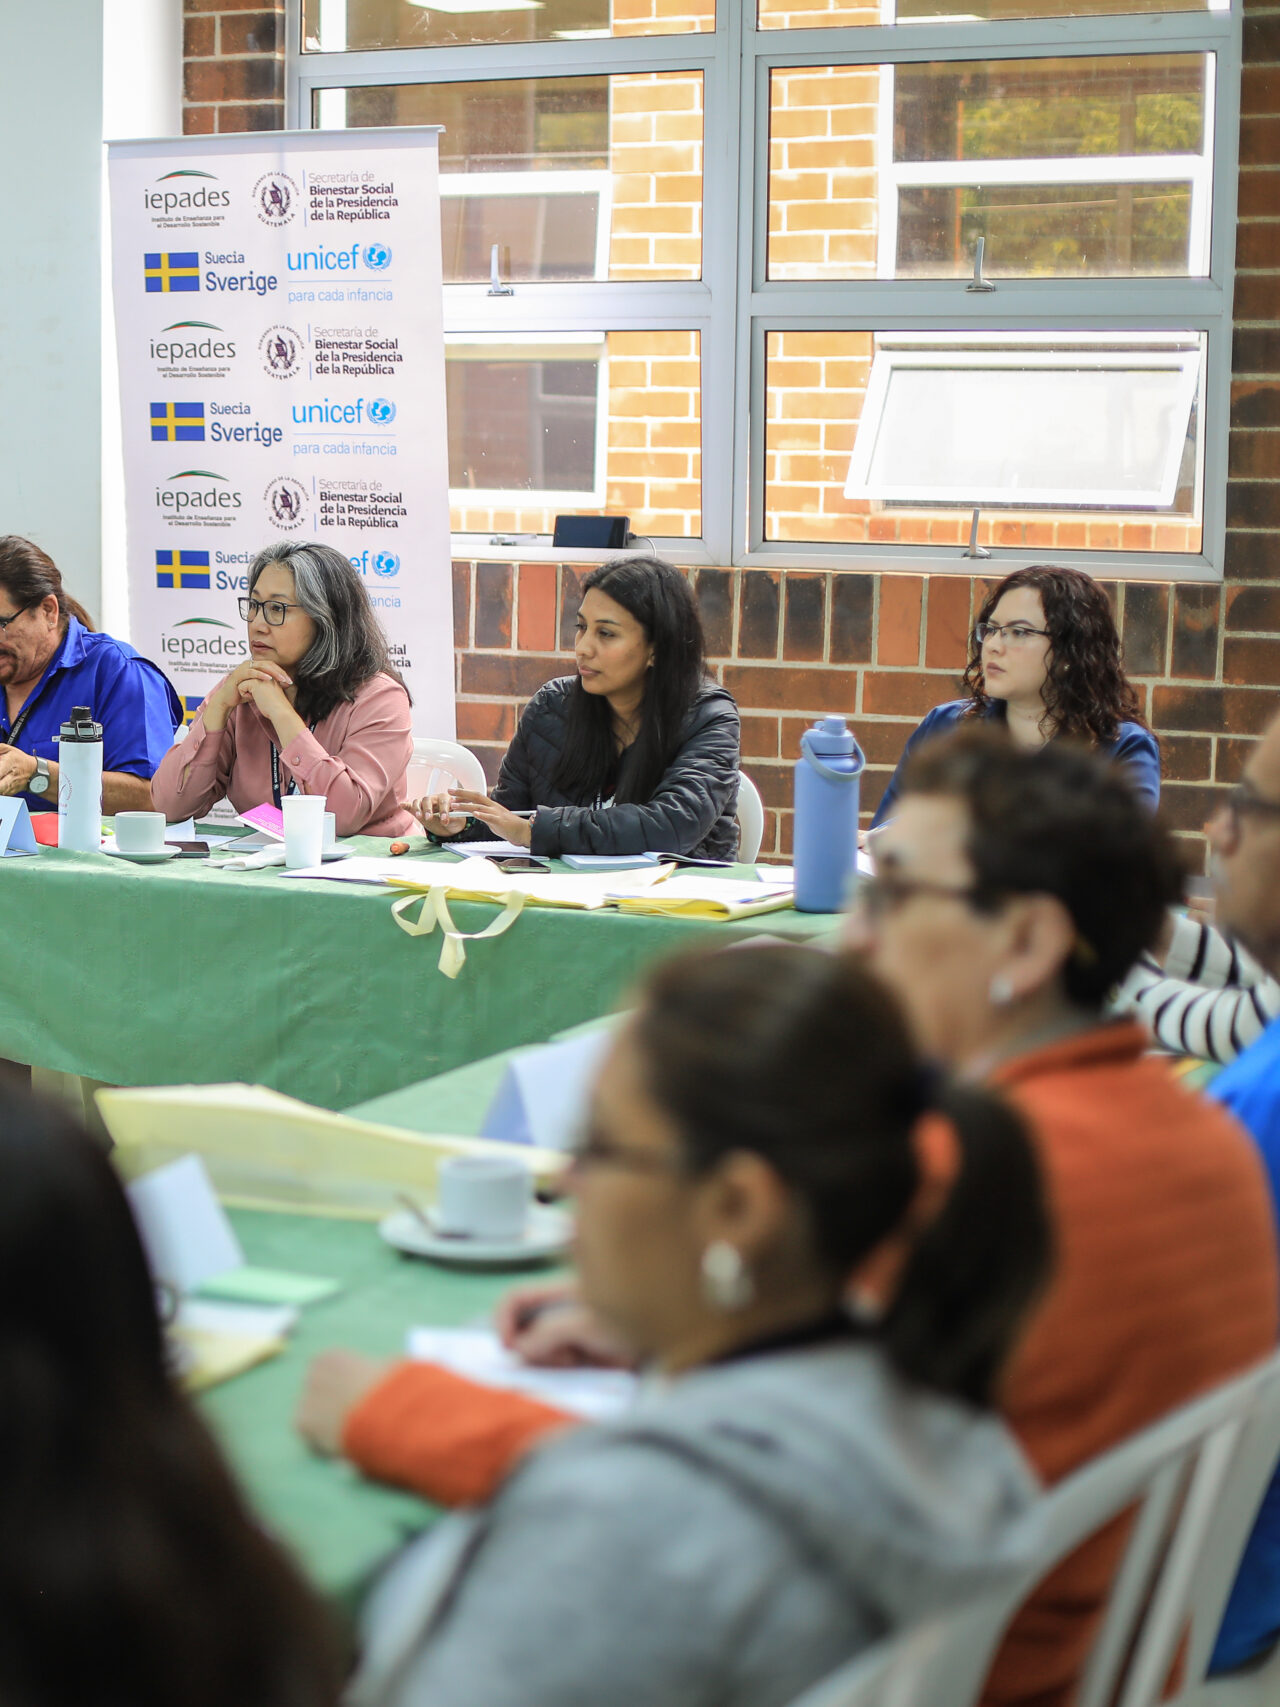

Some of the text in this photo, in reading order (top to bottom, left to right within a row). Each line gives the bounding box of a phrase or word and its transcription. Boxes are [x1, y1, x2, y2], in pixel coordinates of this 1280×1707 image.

[308, 171, 375, 184] Secretaría de
[310, 183, 394, 196] Bienestar Social
[144, 187, 230, 214] iepades
[310, 196, 399, 208] de la Presidencia
[310, 209, 390, 223] de la República
[205, 251, 245, 264] Suecia
[287, 244, 359, 271] unicef
[206, 270, 278, 296] Sverige
[288, 288, 393, 304] para cada infancia
[365, 326, 378, 337] de
[315, 338, 398, 349] Bienestar Social
[150, 338, 236, 364] iepades
[316, 351, 403, 362] de la Presidencia
[316, 363, 395, 377] de la República
[210, 402, 251, 415] Suecia
[292, 398, 364, 424] unicef
[211, 422, 283, 447] Sverige
[293, 442, 397, 456] para cada infancia
[370, 480, 382, 491] de
[156, 487, 242, 512] iepades
[320, 492, 402, 504] Bienestar Social
[320, 504, 407, 516] de la Presidencia
[321, 515, 398, 530] de la República
[371, 595, 401, 608] ancia
[162, 633, 247, 659] iepades
[389, 644, 406, 655] cial
